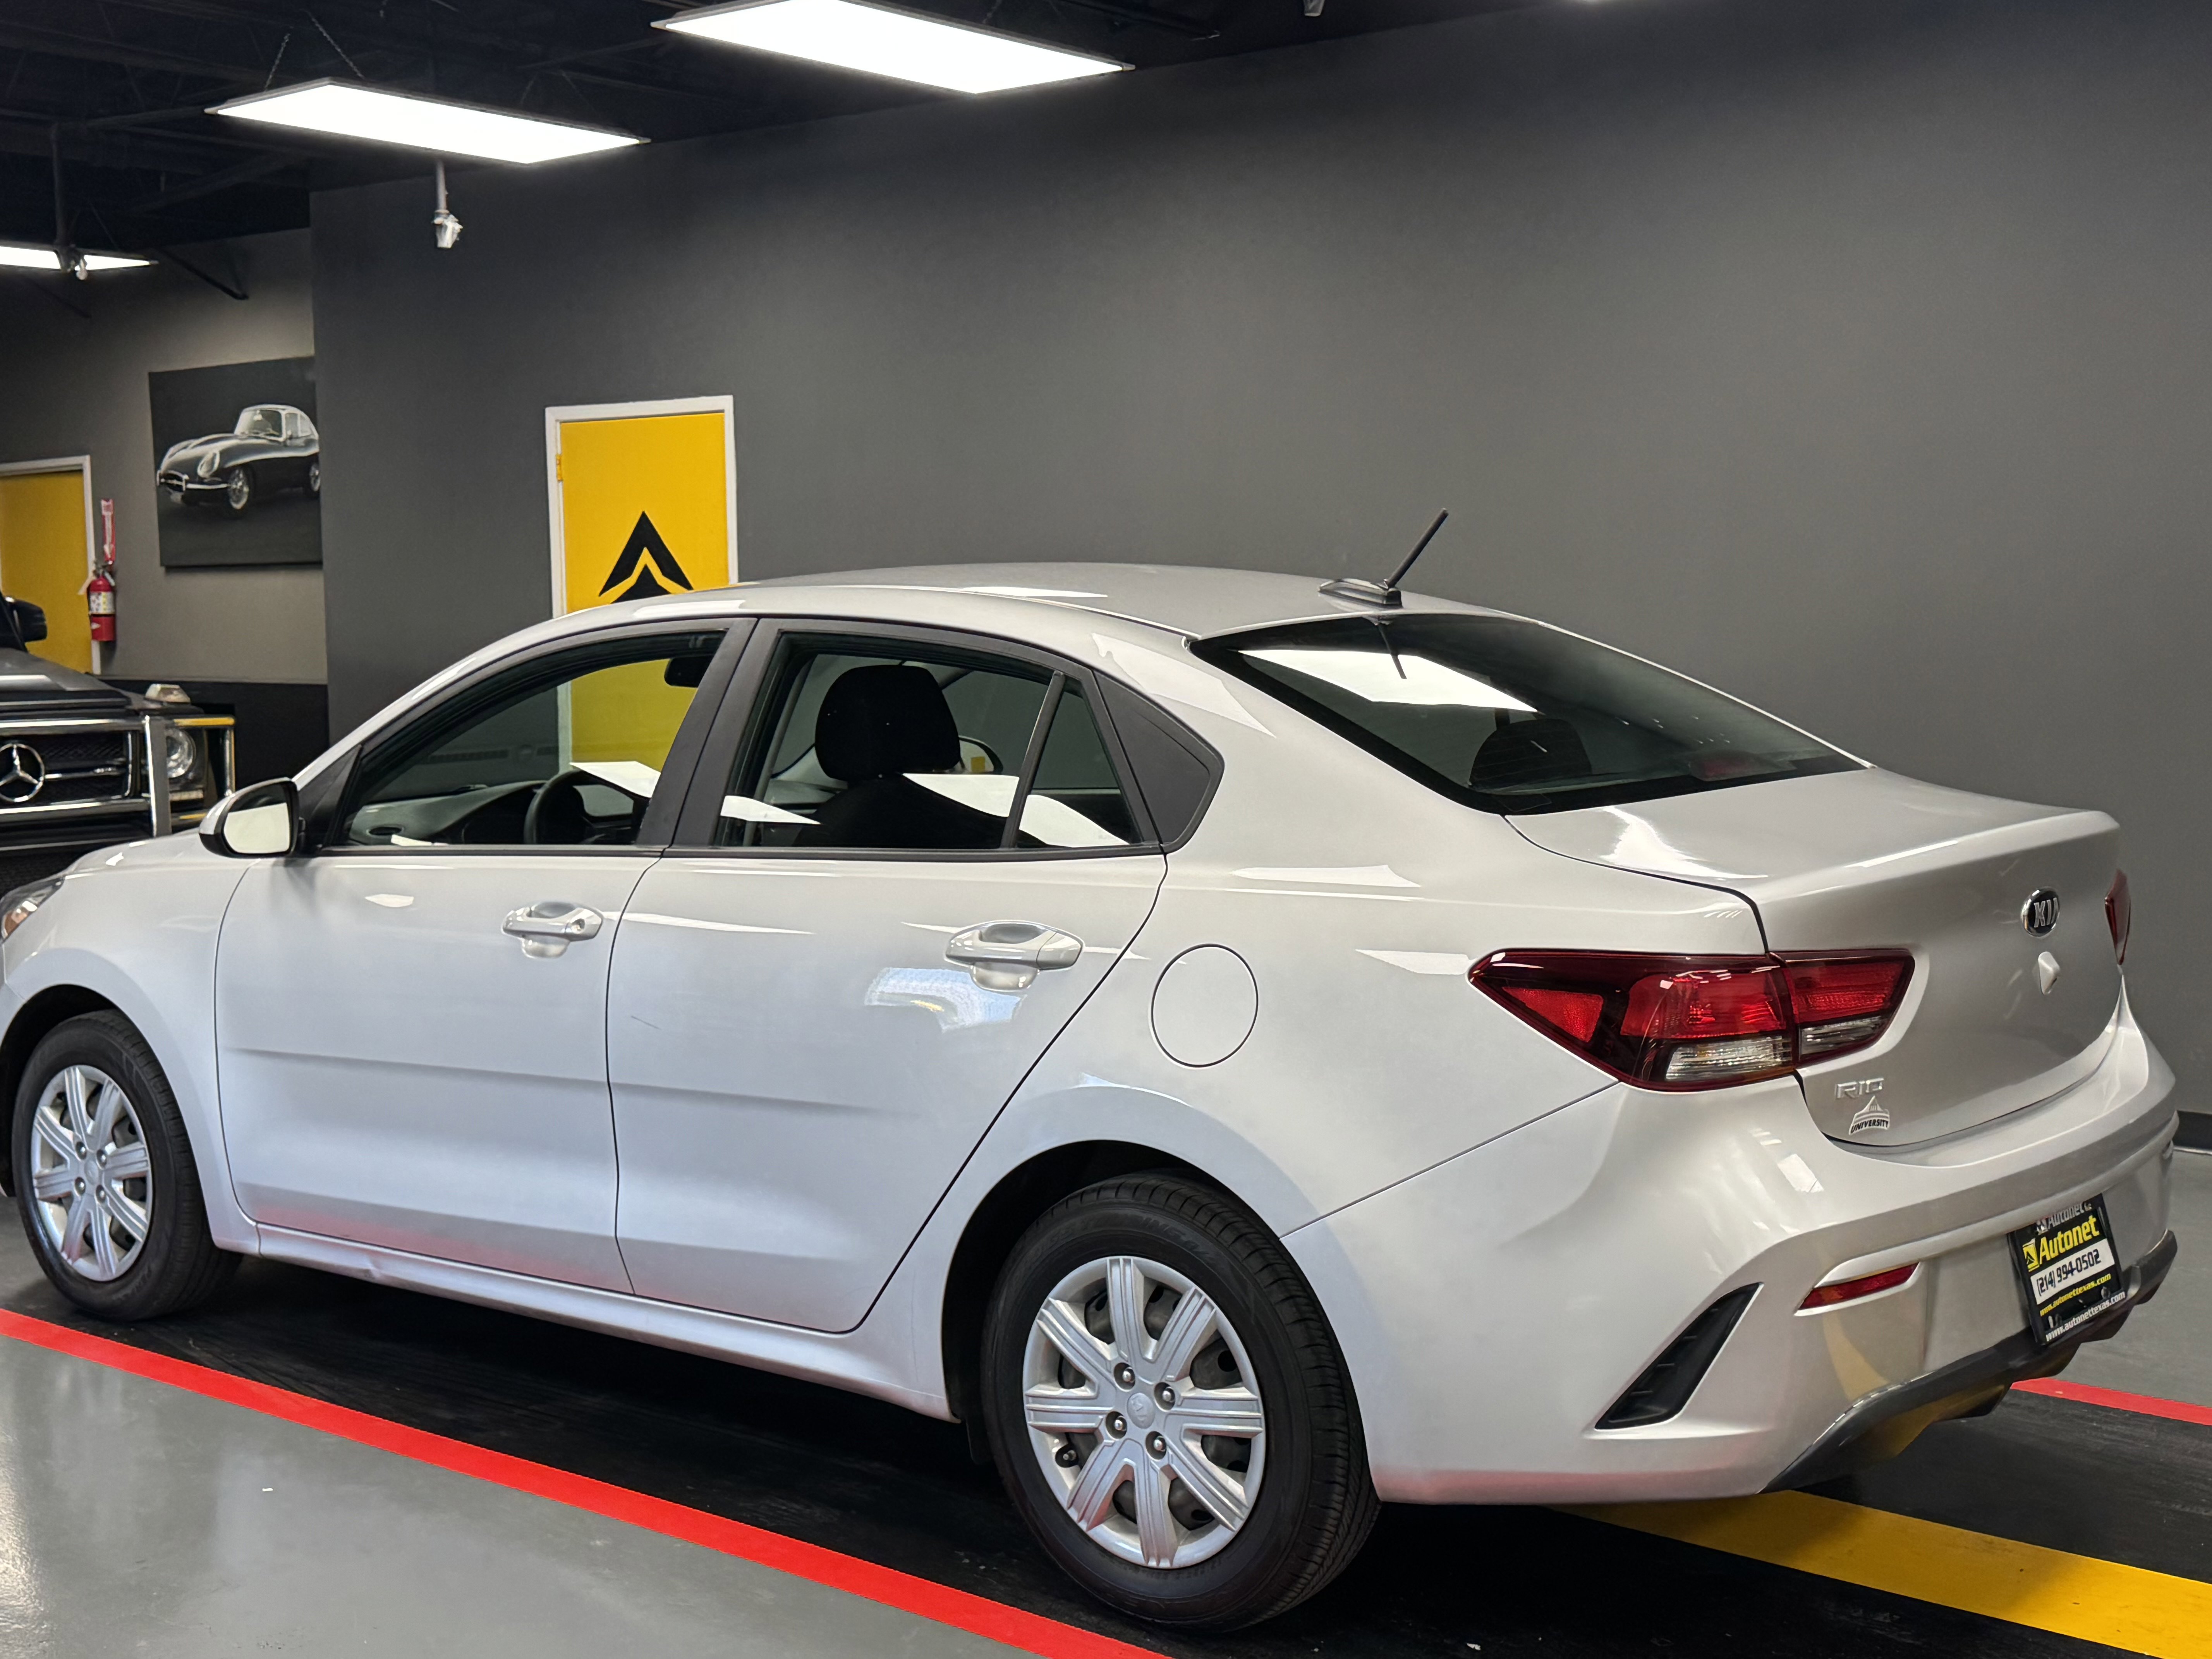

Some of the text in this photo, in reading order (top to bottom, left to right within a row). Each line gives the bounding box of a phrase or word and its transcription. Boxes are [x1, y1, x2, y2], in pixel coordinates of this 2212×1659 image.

[1835, 1078, 1884, 1099] RIO
[1850, 1119, 1889, 1134] UNIVERSITY
[2039, 1215, 2100, 1265] Autonet
[2036, 1249, 2102, 1297] (214) 994-0502
[2040, 1273, 2112, 1317] www.autonettexas.com
[2045, 1291, 2126, 1342] www.autonettexas.com
